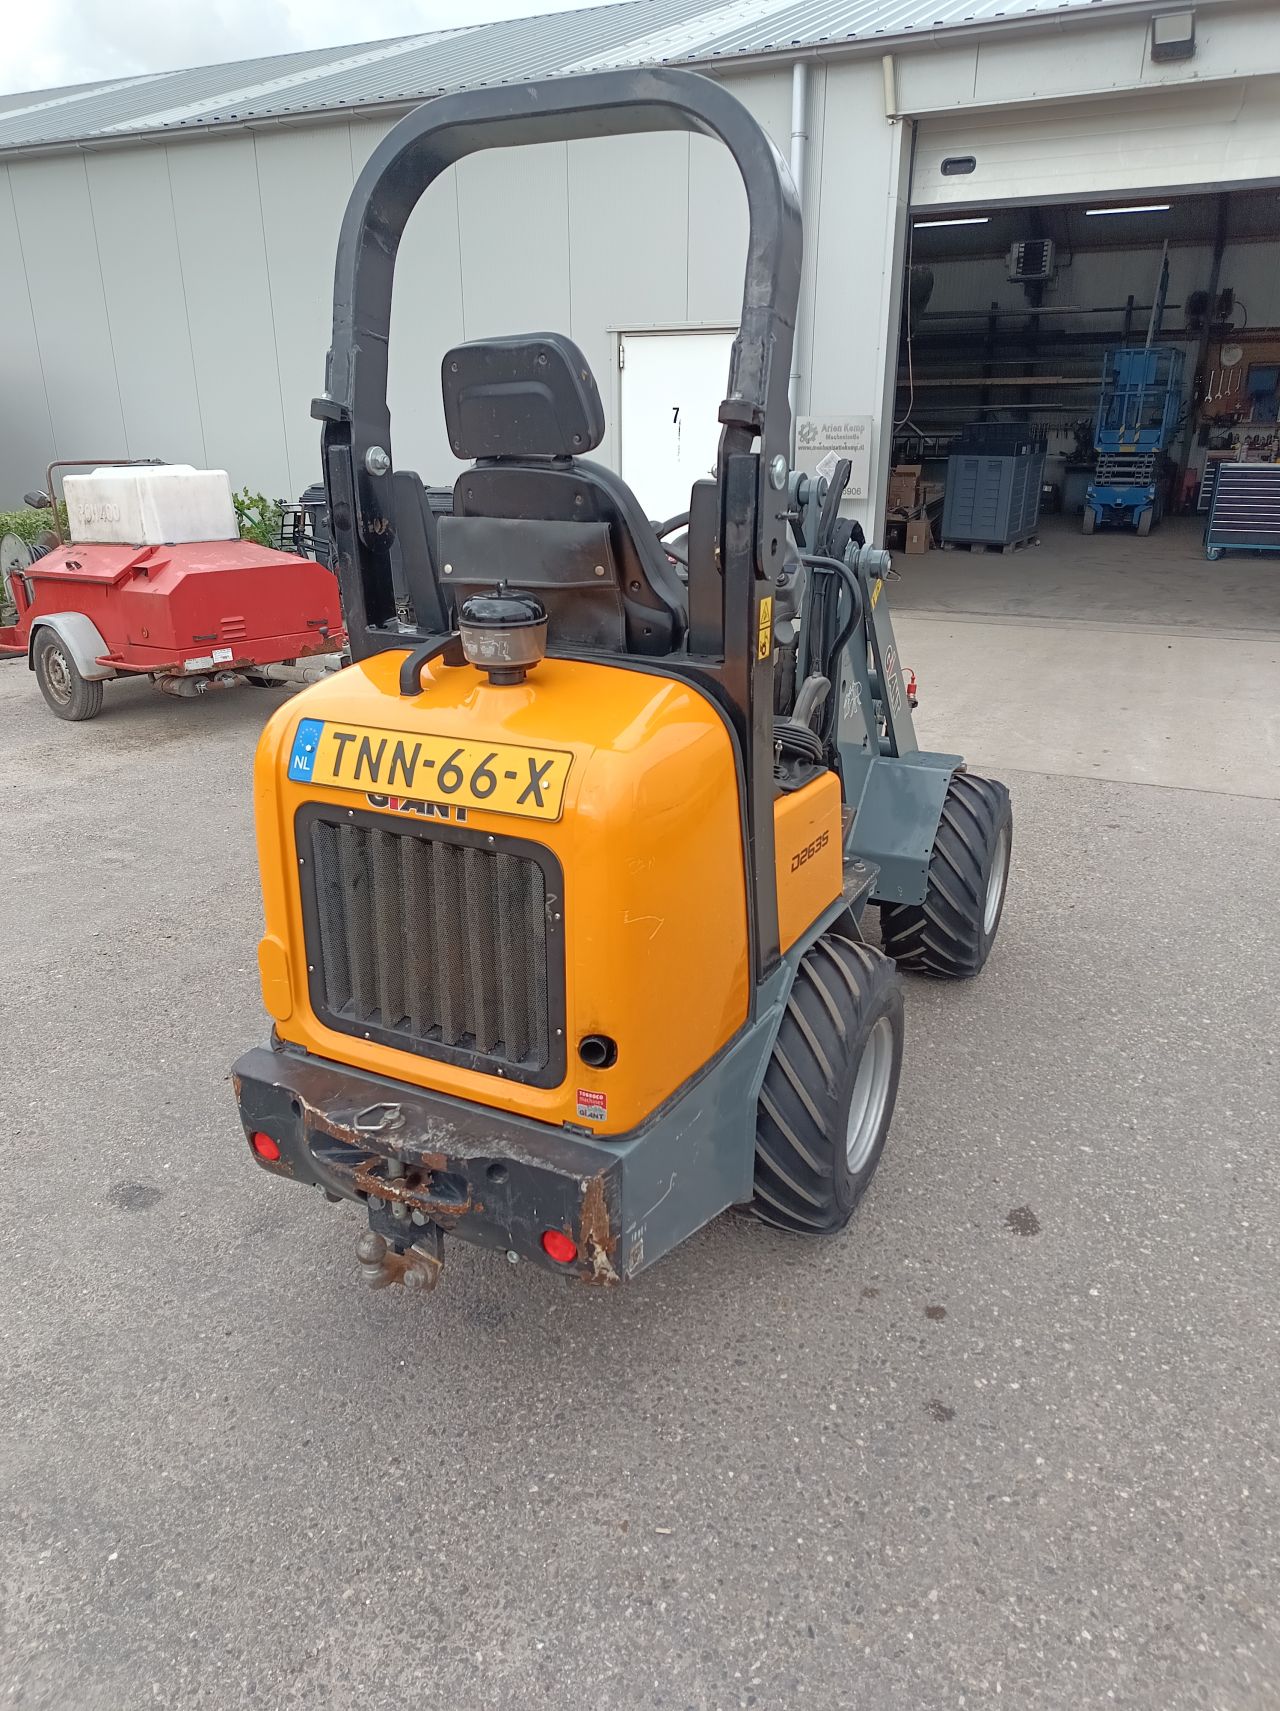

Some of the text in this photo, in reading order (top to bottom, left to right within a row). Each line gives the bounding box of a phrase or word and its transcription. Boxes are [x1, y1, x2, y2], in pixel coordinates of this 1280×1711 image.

[672, 407, 680, 424] 7
[294, 755, 311, 771] NL
[332, 731, 555, 808] TNN-66-X
